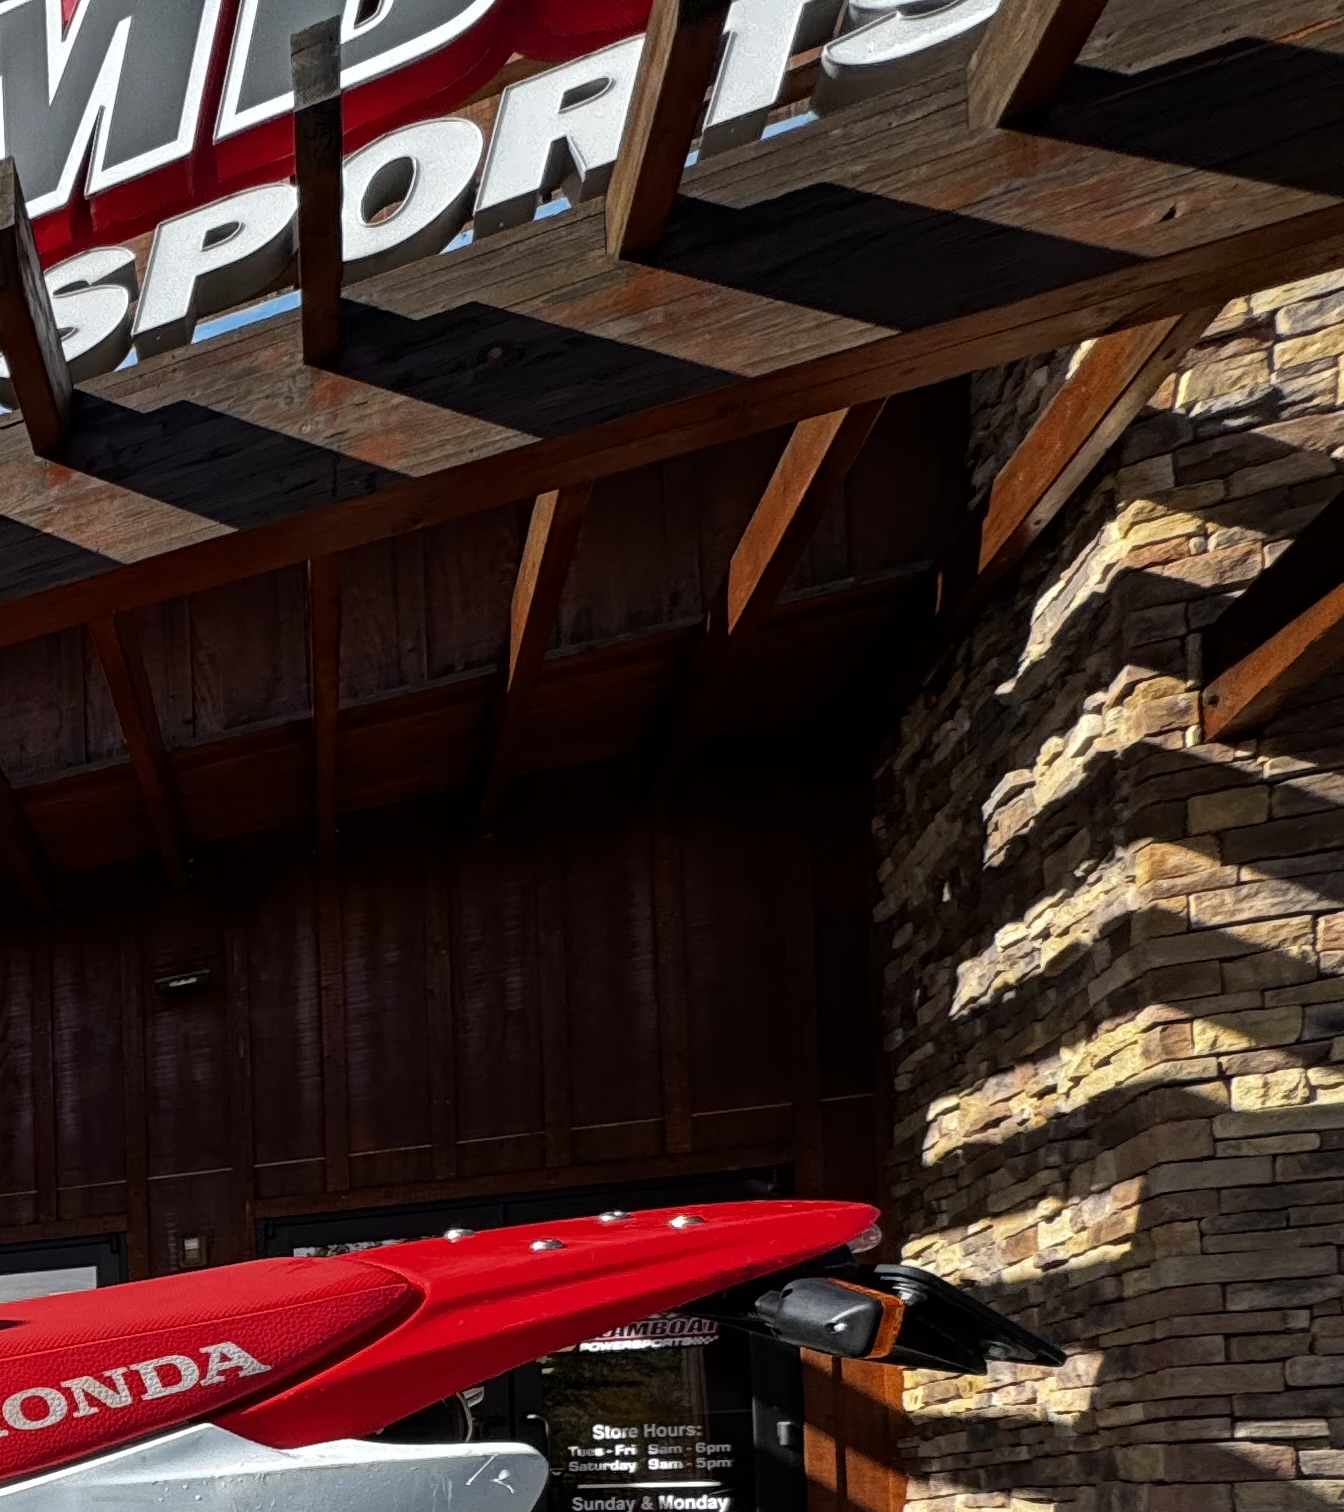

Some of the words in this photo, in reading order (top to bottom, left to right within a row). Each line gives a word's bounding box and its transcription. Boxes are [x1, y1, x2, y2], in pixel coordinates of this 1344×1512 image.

[592, 1424, 638, 1440] Store
[643, 1423, 703, 1438] Hours:
[568, 1445, 605, 1457] Tues
[614, 1444, 638, 1456] Fri
[695, 1442, 732, 1455] 6pm
[568, 1460, 638, 1473] Saturday
[647, 1458, 684, 1470] 9am
[695, 1457, 732, 1470] 5pm
[641, 1496, 653, 1510] &
[658, 1494, 730, 1512] Monday
